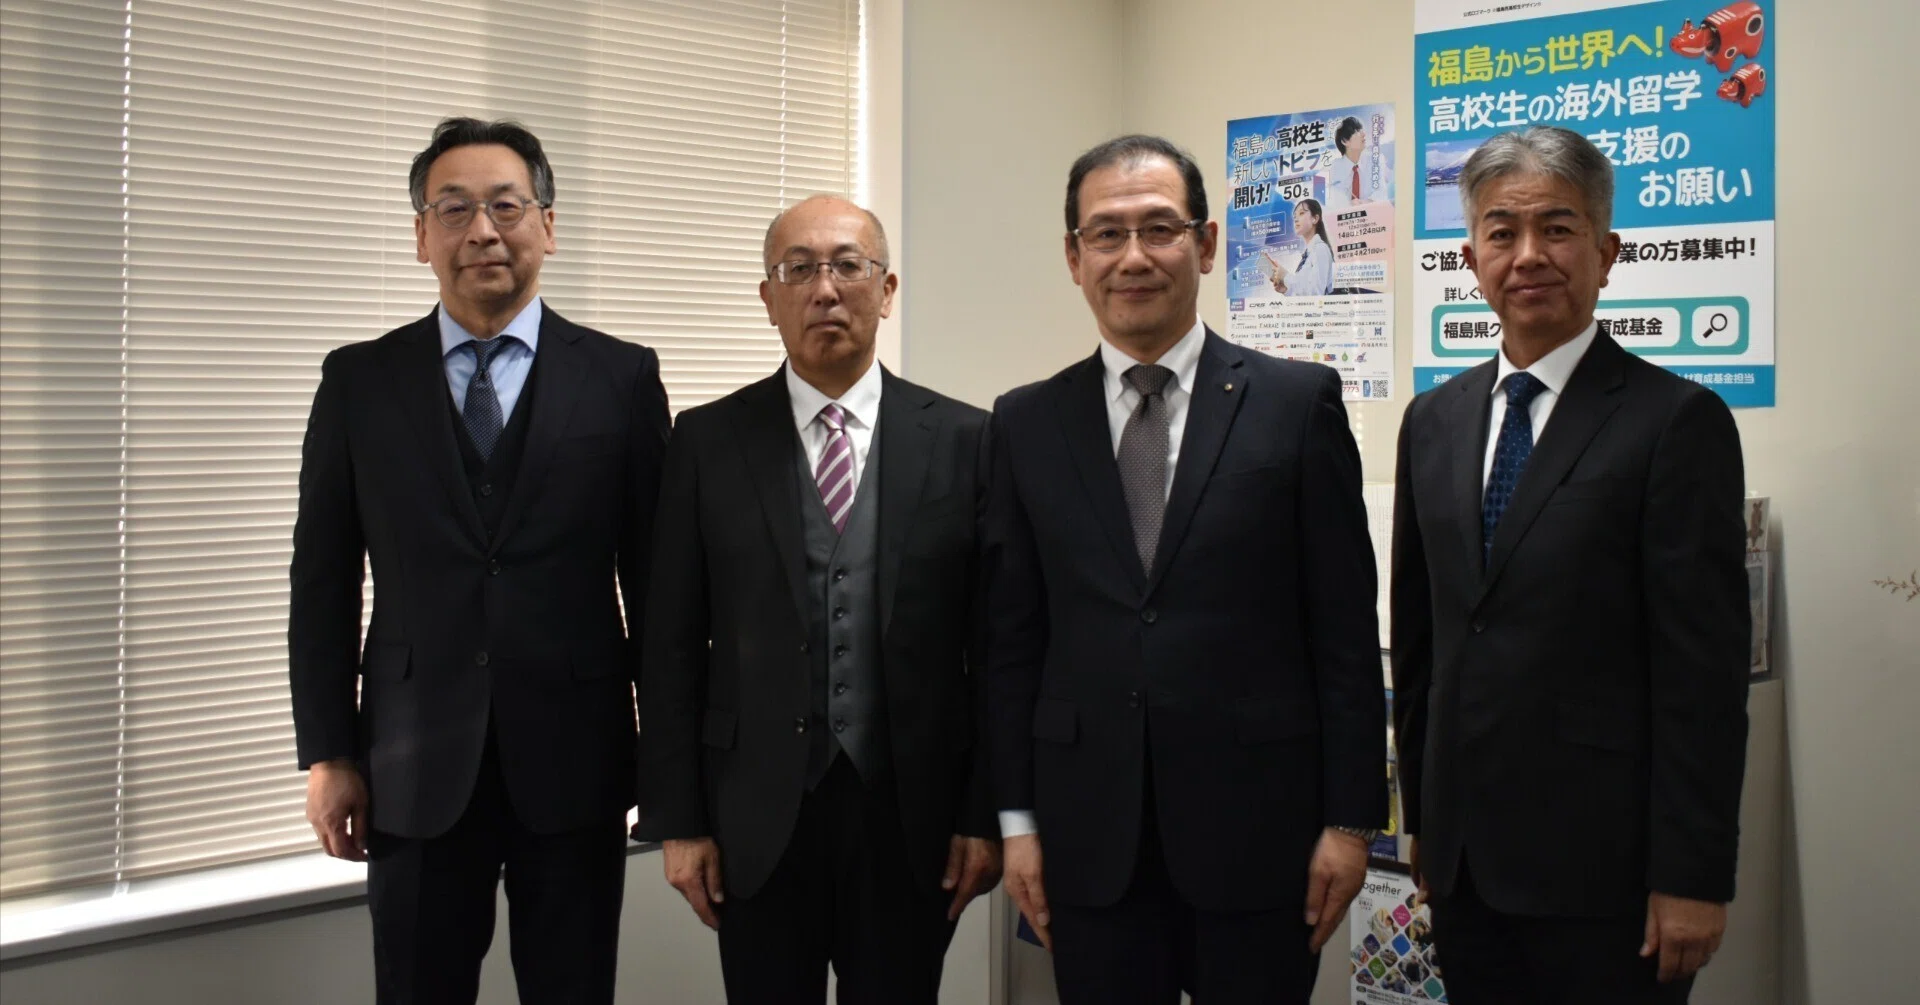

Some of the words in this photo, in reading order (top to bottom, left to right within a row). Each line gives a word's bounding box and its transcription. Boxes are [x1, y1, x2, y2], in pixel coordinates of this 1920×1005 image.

[1428, 26, 1663, 87] 福島から世界へ！
[1429, 70, 1702, 134] 高校生の海外留学
[1586, 125, 1690, 166] 支援の
[1234, 148, 1332, 185] 新しいトビラを
[1234, 183, 1271, 209] 開け！
[1639, 167, 1752, 207] お願い
[1613, 237, 1755, 264] 業の方募集中！
